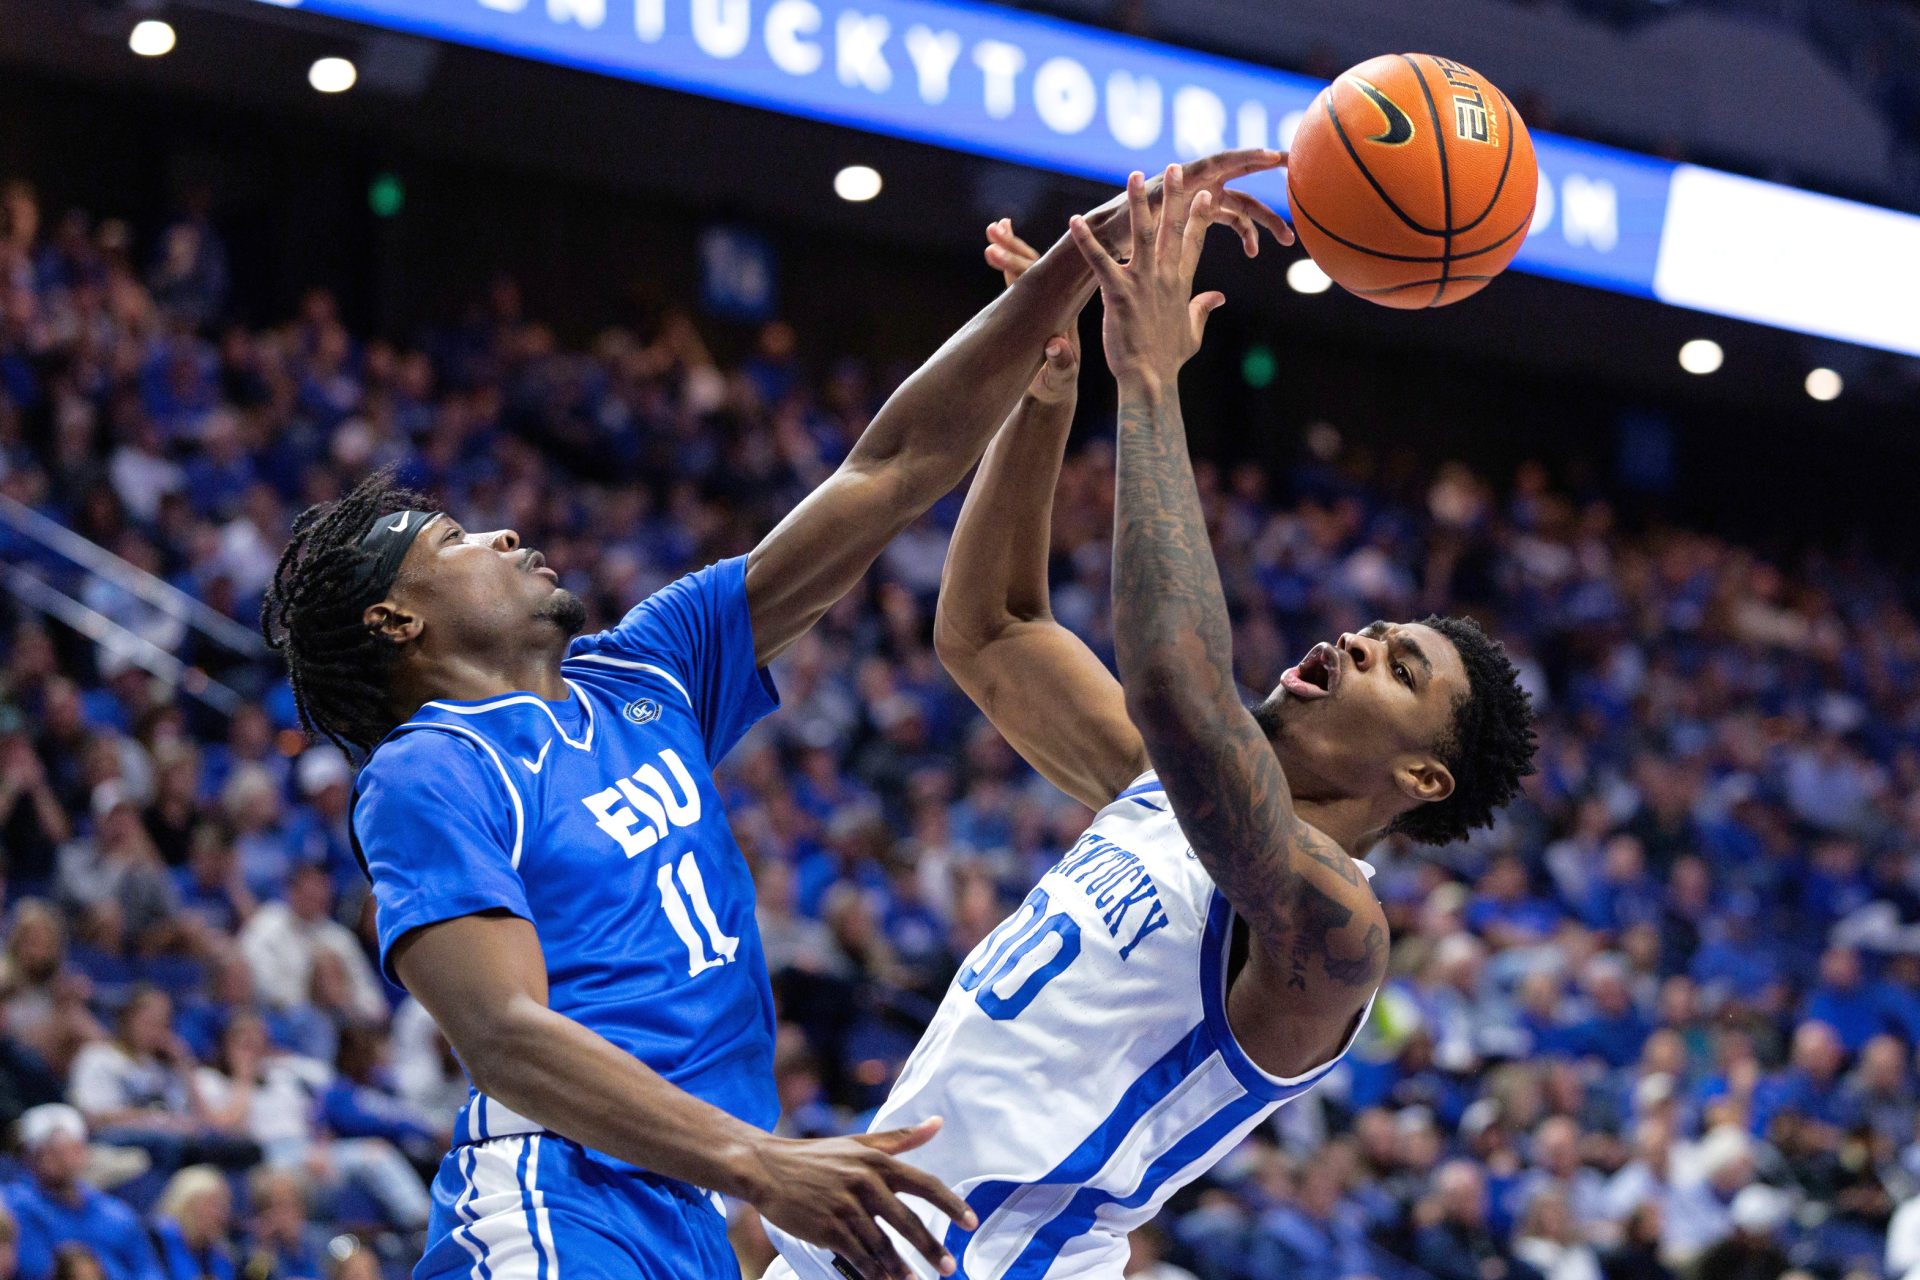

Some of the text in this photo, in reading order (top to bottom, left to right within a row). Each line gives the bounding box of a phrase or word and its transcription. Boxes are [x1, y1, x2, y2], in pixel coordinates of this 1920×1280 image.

[581, 748, 701, 859] EIU
[656, 850, 740, 978] 11
[957, 886, 1082, 1021] 00
